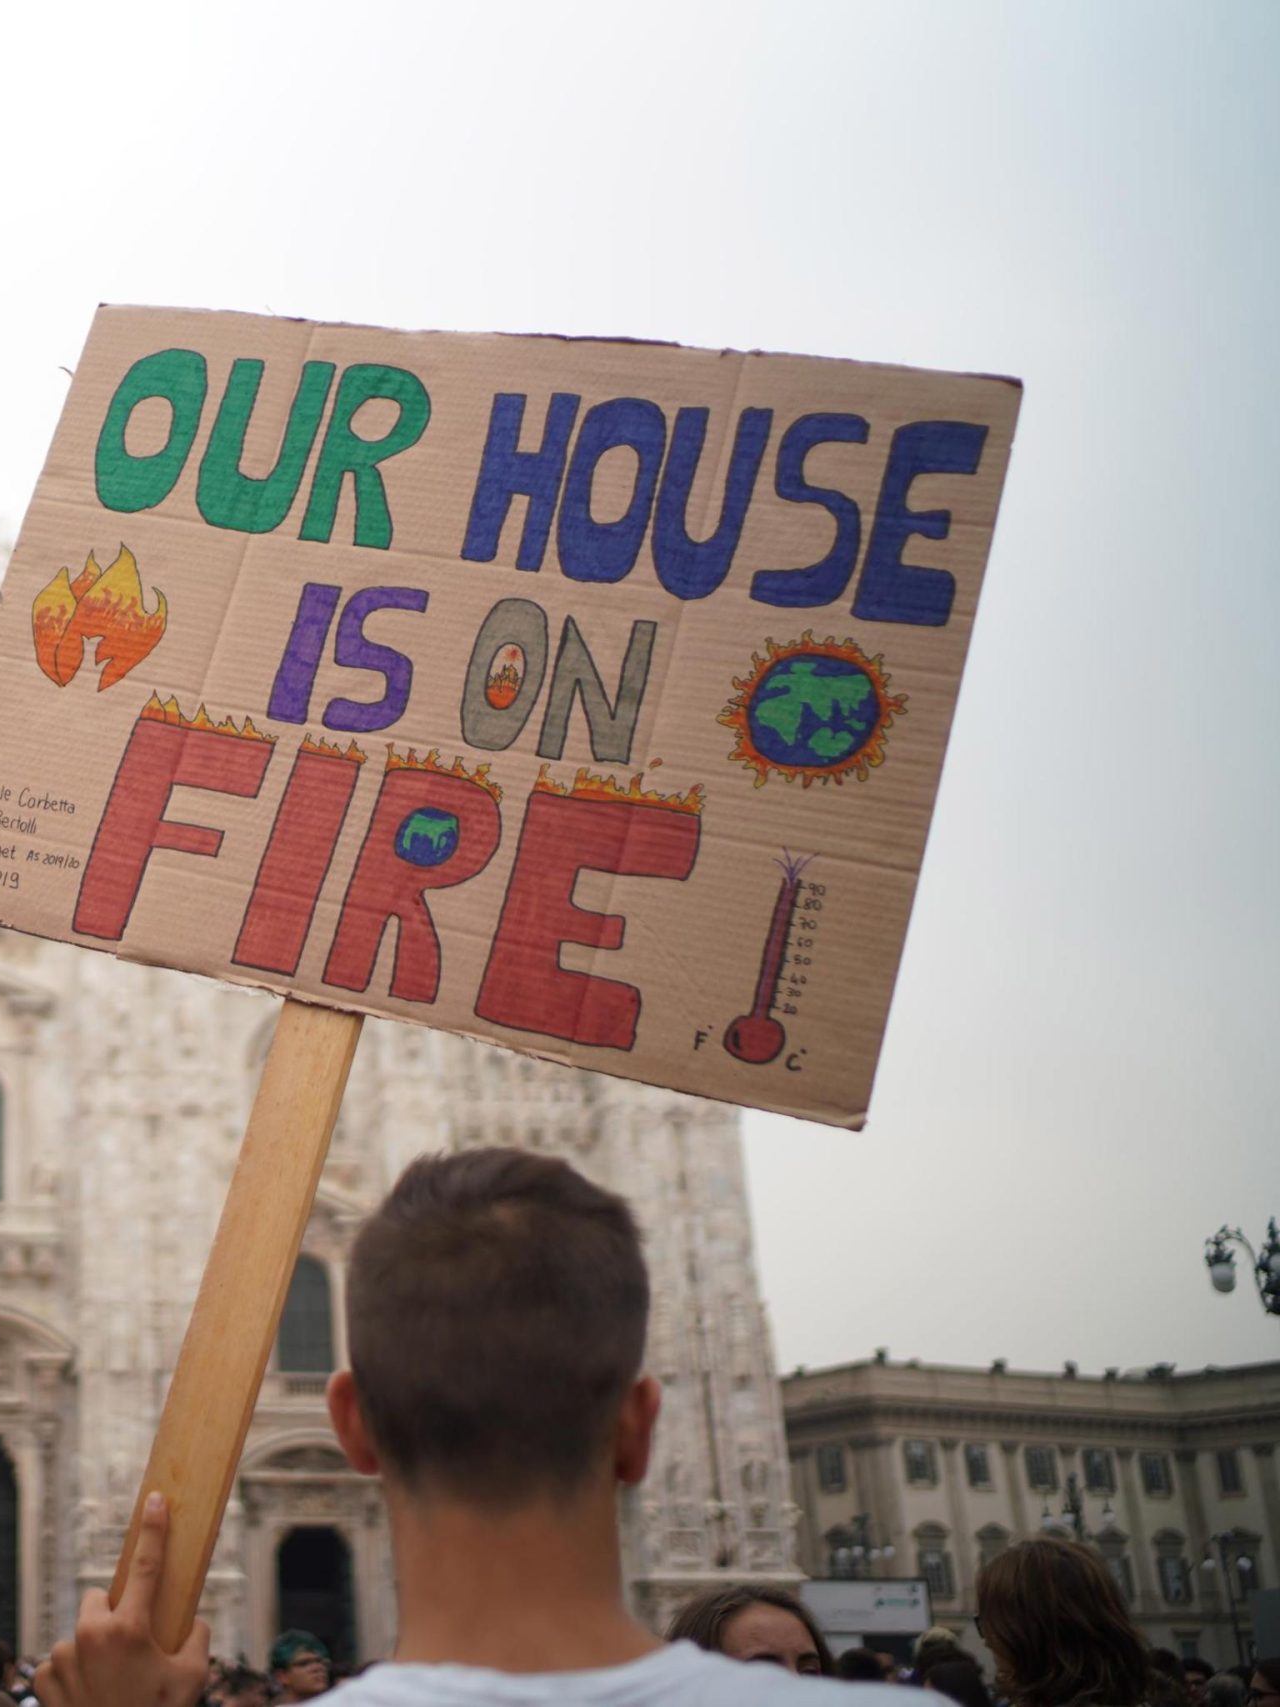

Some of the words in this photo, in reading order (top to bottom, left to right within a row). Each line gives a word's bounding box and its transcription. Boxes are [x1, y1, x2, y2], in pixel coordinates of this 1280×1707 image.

[95, 348, 431, 549] OUR
[460, 392, 989, 626] HOUSE
[267, 582, 429, 732] IS
[460, 598, 657, 765] ON
[18, 787, 76, 814] Corbetta
[73, 717, 701, 1052] FIRE
[808, 882, 826, 896] 90
[803, 897, 822, 911] 80
[799, 916, 817, 930] 70
[794, 954, 811, 966] 50
[783, 1003, 798, 1015] 20
